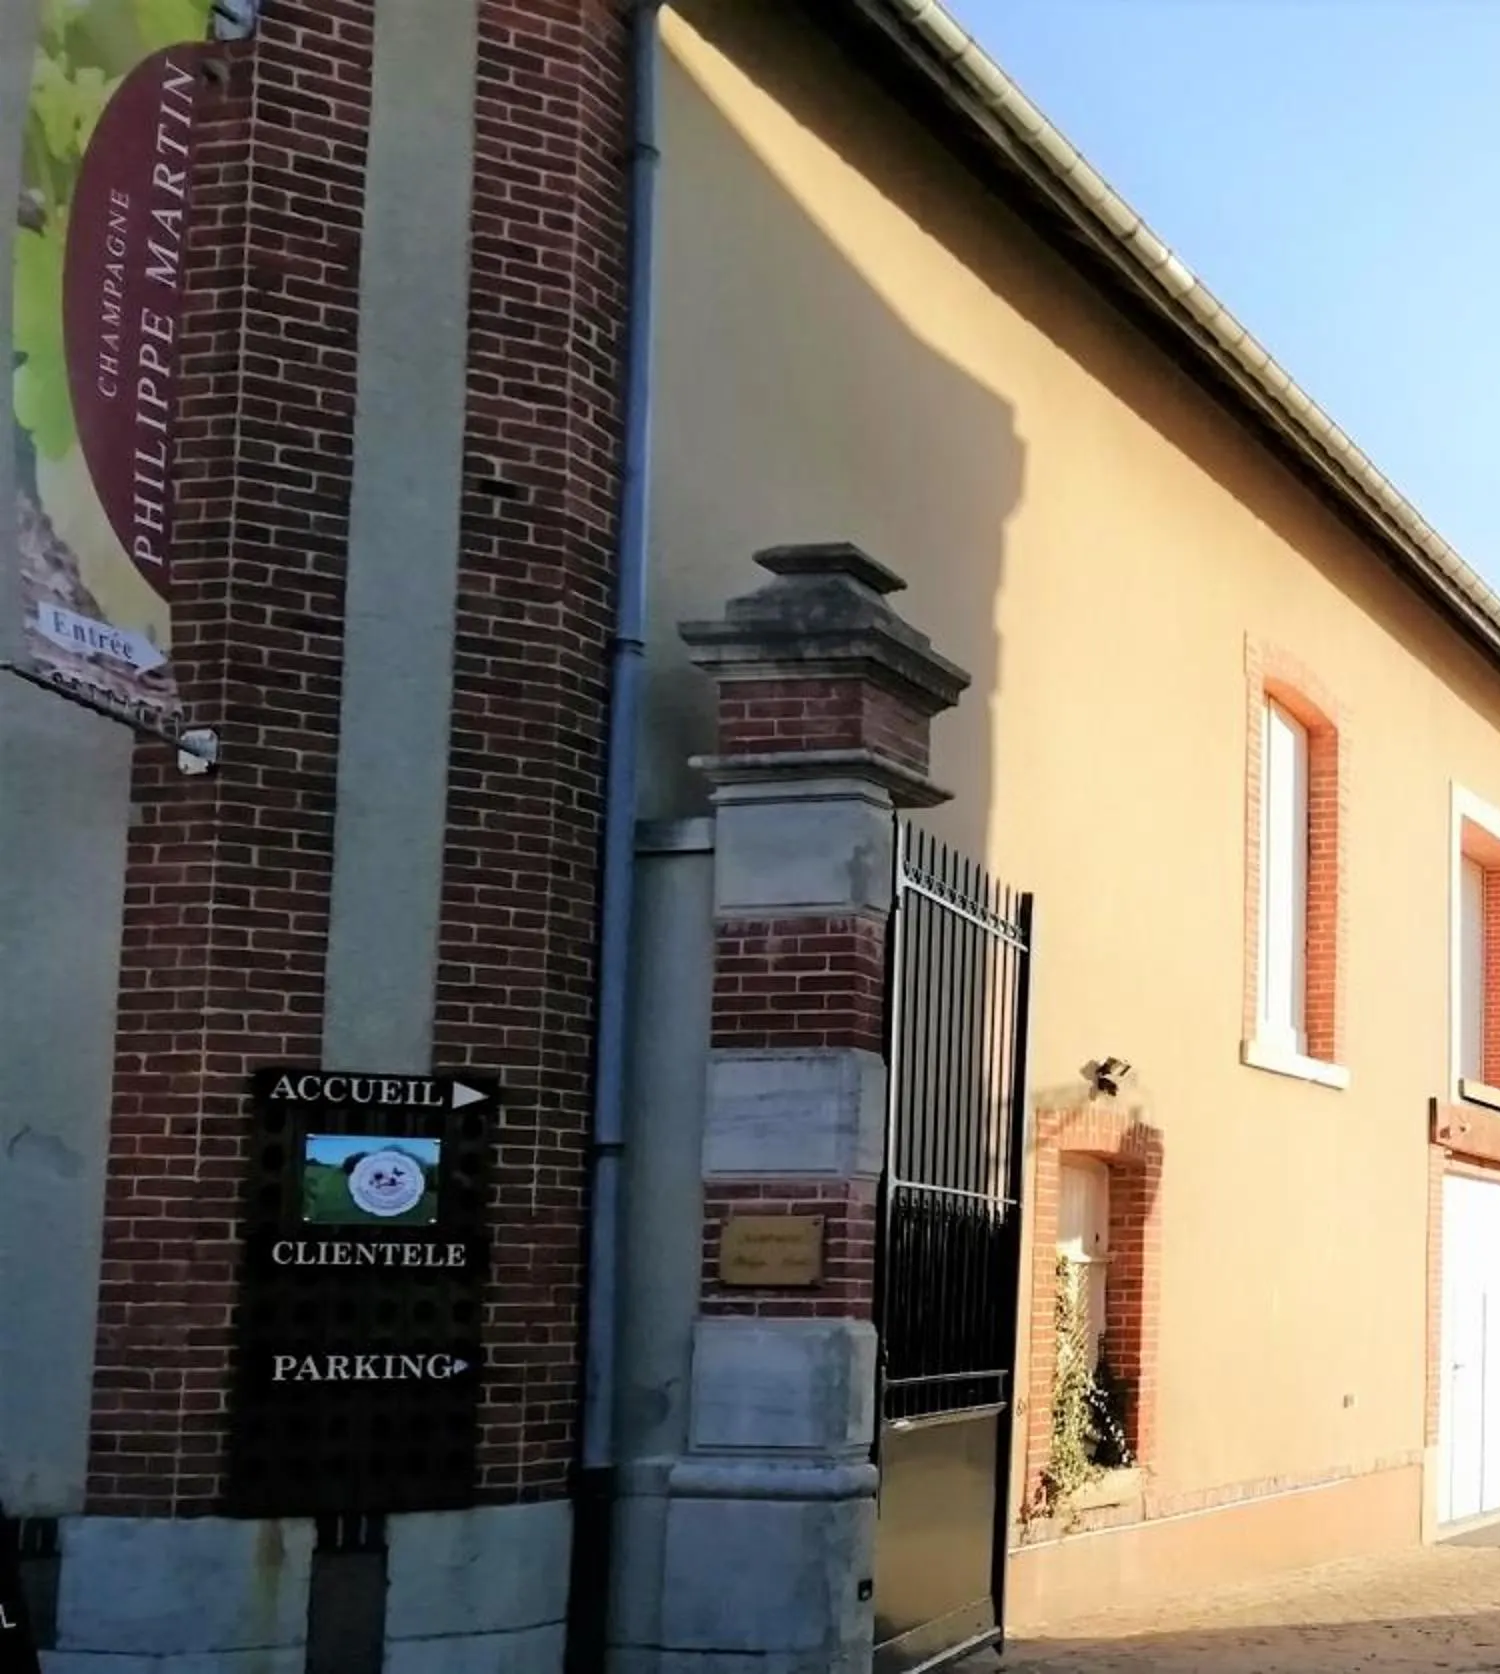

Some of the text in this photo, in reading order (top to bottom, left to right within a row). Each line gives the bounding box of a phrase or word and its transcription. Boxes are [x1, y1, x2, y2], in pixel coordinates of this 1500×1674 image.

[97, 188, 130, 399] CHAMPAGNE
[133, 56, 196, 567] PHILIPPE MARTIN
[52, 610, 134, 660] Entrée
[270, 1074, 444, 1107] ACCUEIL
[271, 1241, 466, 1268] CLIENTELE
[271, 1353, 453, 1382] PARKING
